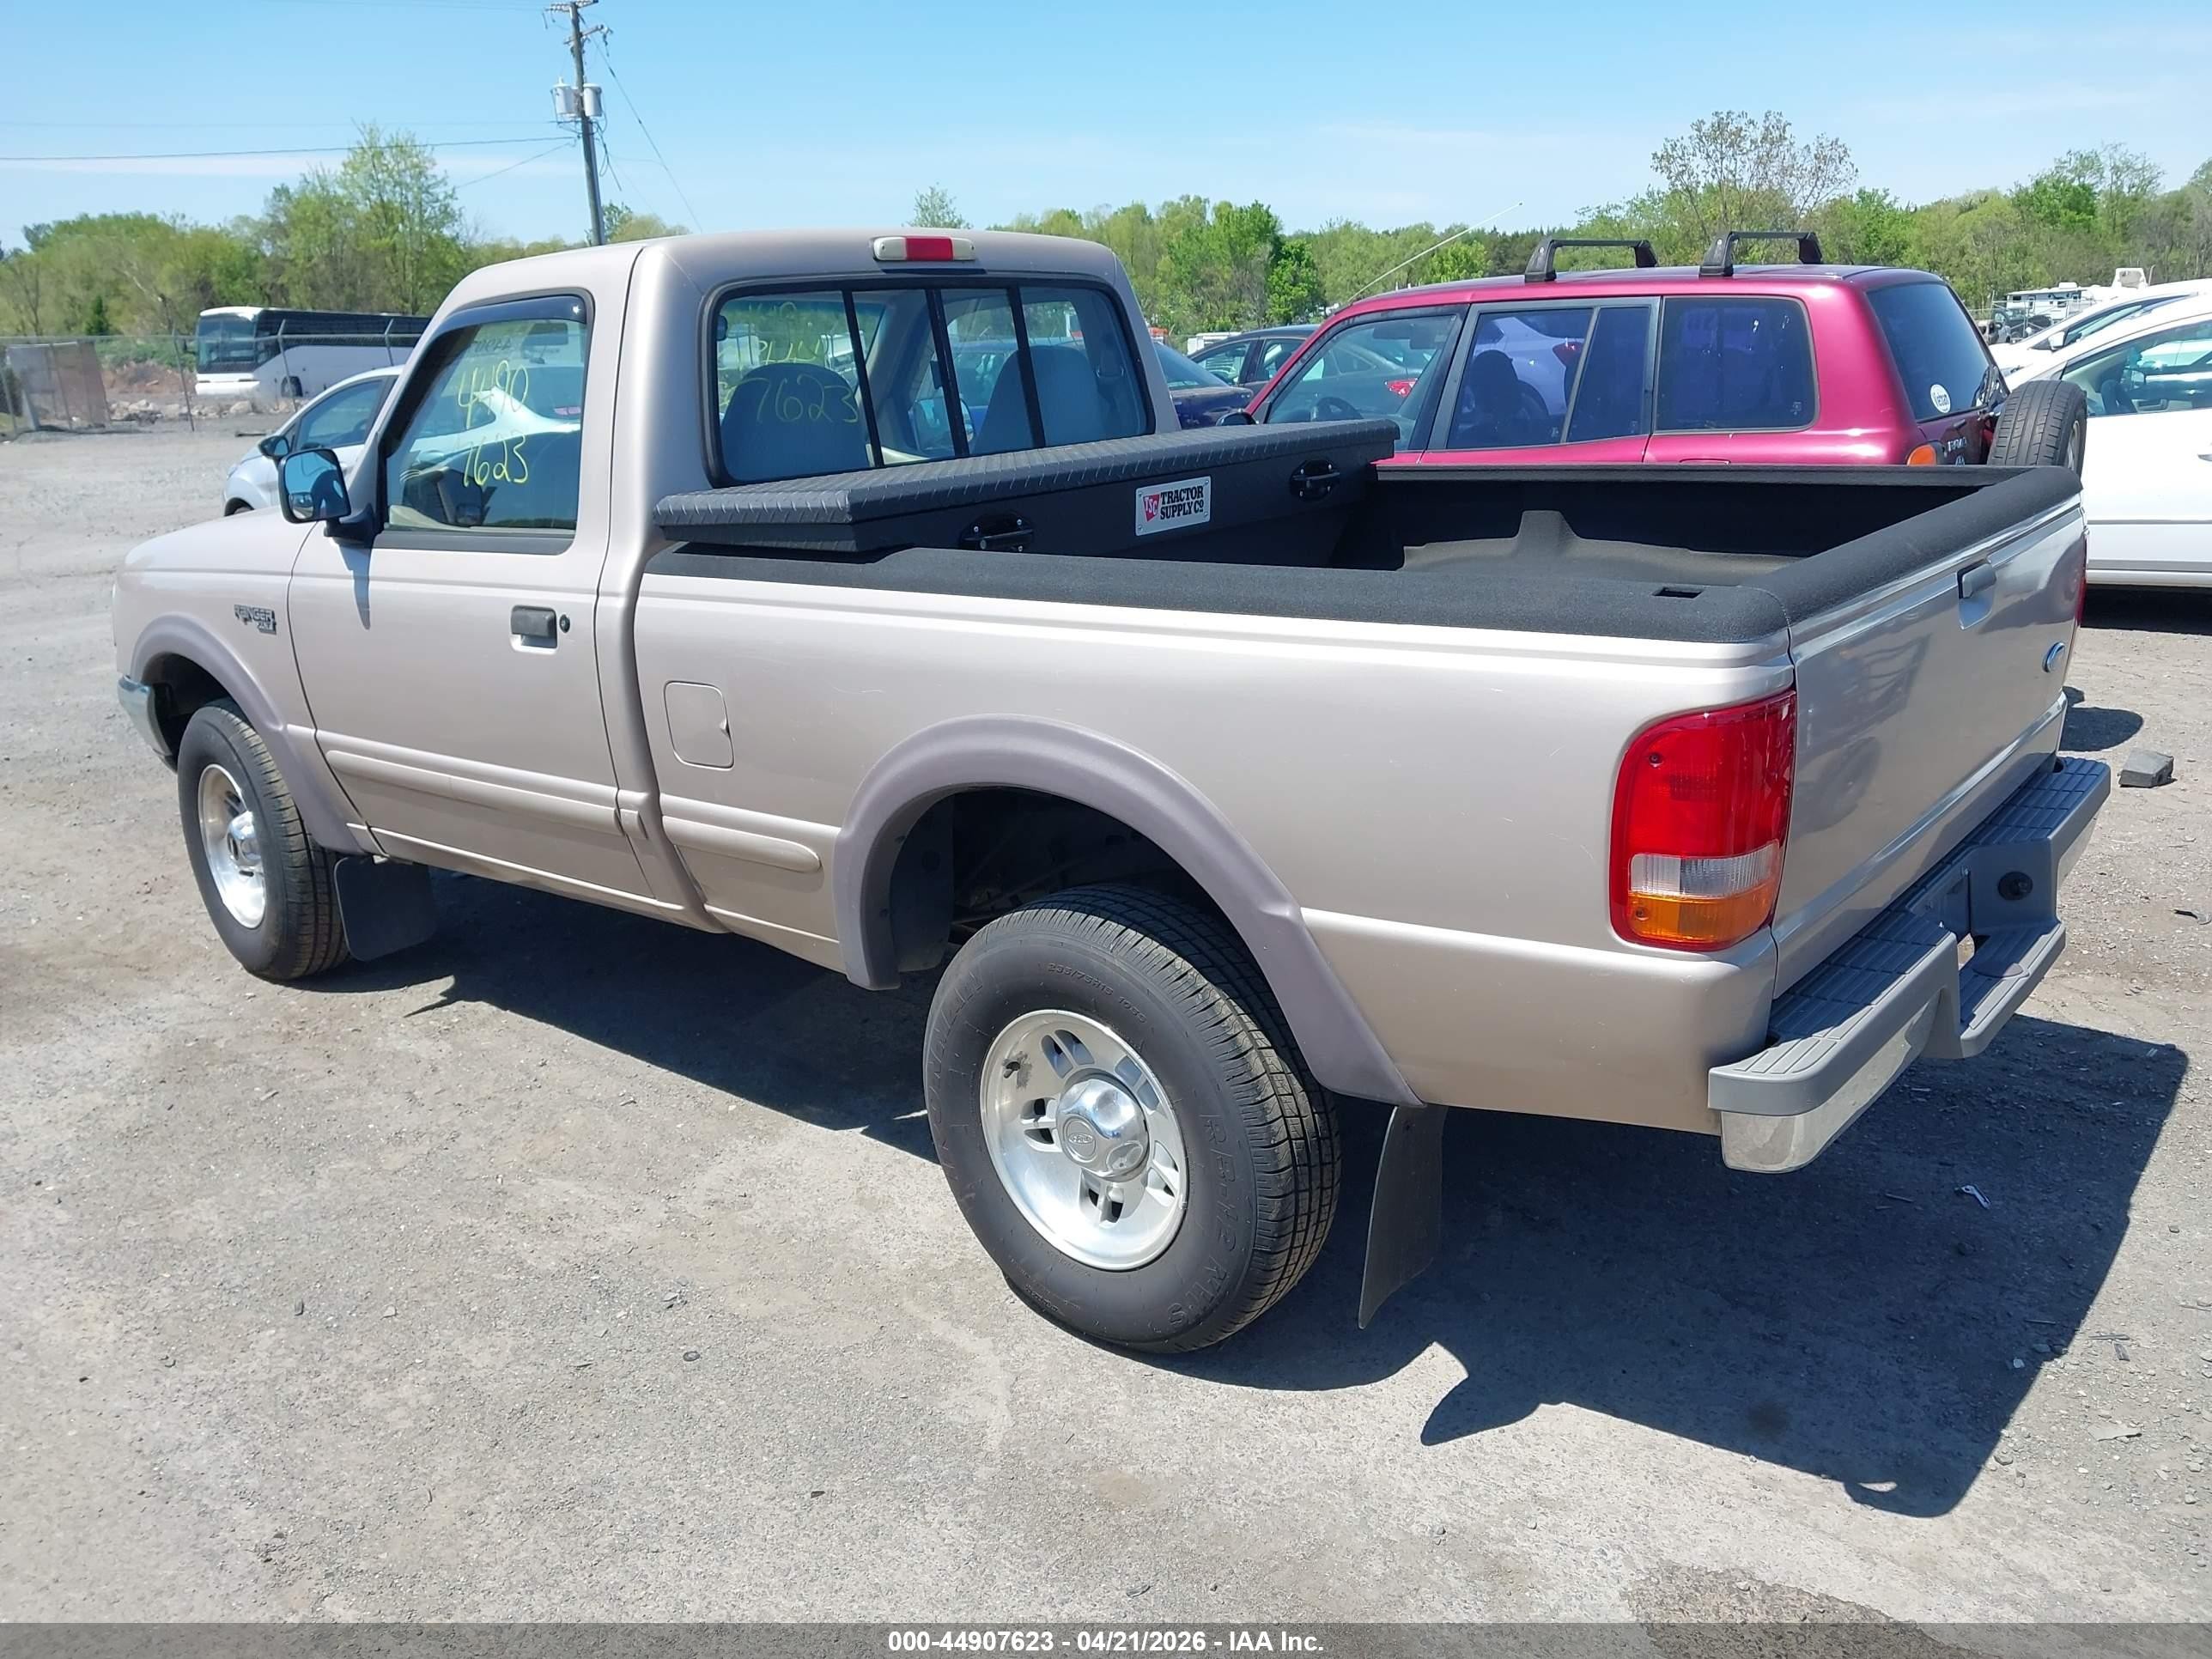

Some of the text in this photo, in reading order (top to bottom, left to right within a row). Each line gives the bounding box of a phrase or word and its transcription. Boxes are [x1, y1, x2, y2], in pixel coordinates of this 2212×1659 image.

[458, 359, 529, 429] 4490
[730, 373, 859, 424] 7623
[457, 429, 529, 488] 7623
[1144, 495, 1158, 516] TSC
[1160, 485, 1204, 506] TRACTOR
[1160, 501, 1194, 520] SUPPLY
